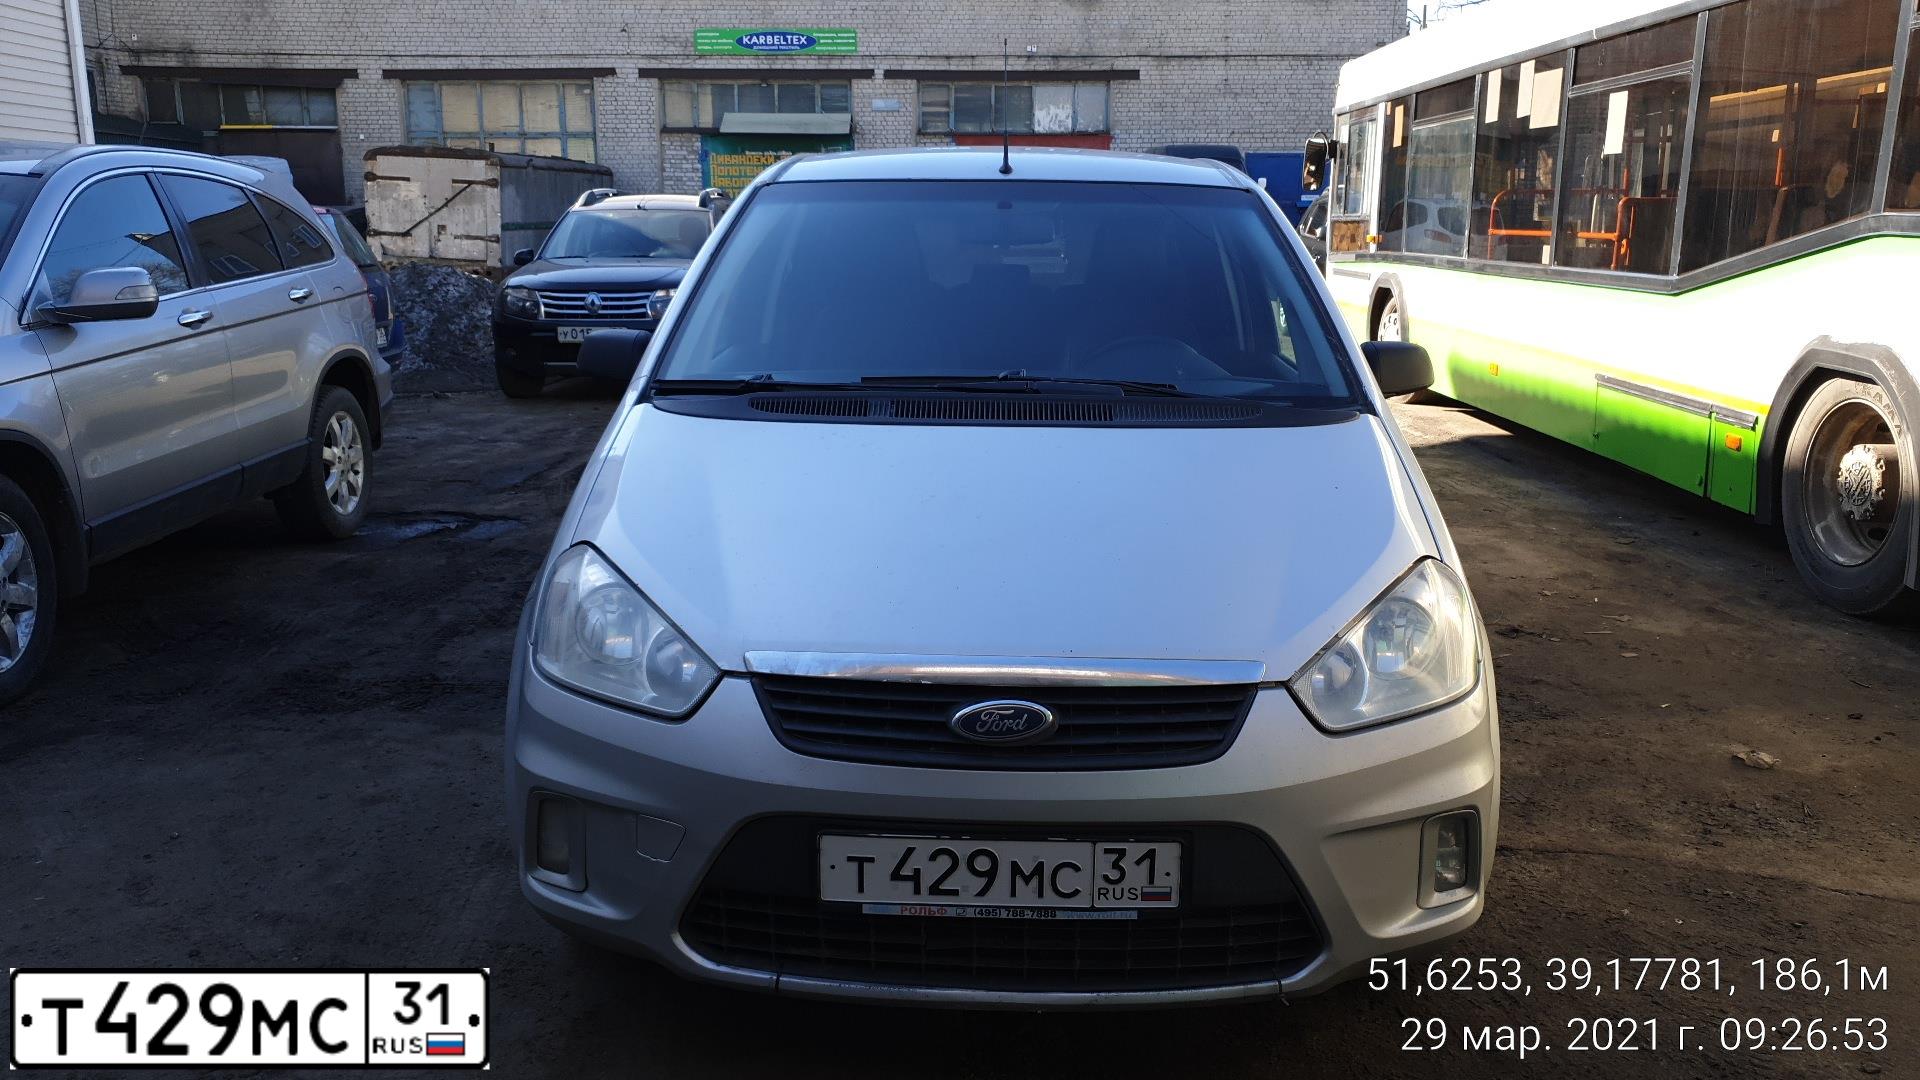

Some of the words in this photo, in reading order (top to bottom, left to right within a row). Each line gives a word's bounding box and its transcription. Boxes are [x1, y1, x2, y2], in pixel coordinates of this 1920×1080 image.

[742, 35, 807, 45] KARBELTEX
[976, 709, 1028, 732] Ford
[1102, 847, 1157, 885] 31
[1097, 886, 1139, 901] RUS
[900, 905, 947, 916] РОЛЬФ
[973, 907, 1002, 918] (495)
